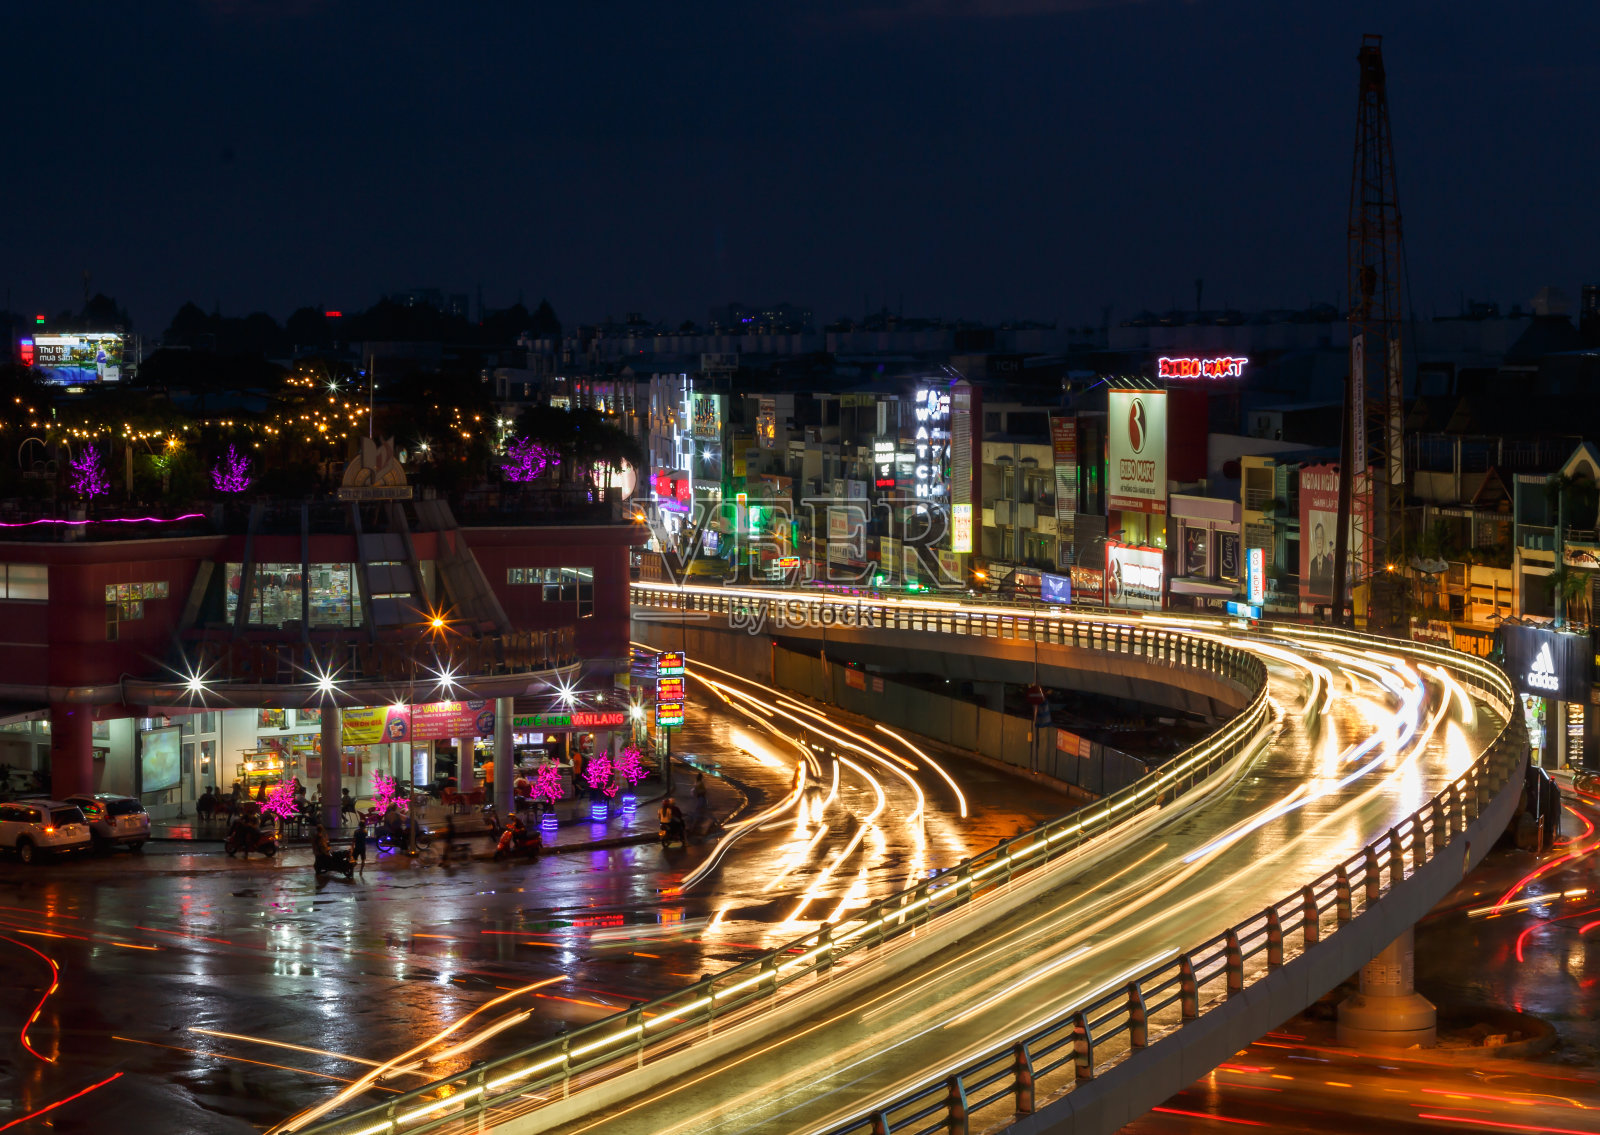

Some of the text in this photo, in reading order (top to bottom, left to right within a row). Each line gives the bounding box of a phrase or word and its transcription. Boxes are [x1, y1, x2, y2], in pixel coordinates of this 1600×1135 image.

[1159, 356, 1248, 379] BIBO MART
[1120, 458, 1155, 483] BIBO MART
[1253, 553, 1259, 566] GO
[1528, 671, 1559, 691] adidas
[513, 715, 542, 727] CAFÉ
[548, 715, 571, 726] KEM
[571, 712, 594, 726] VĂN
[594, 713, 624, 725] LANG
